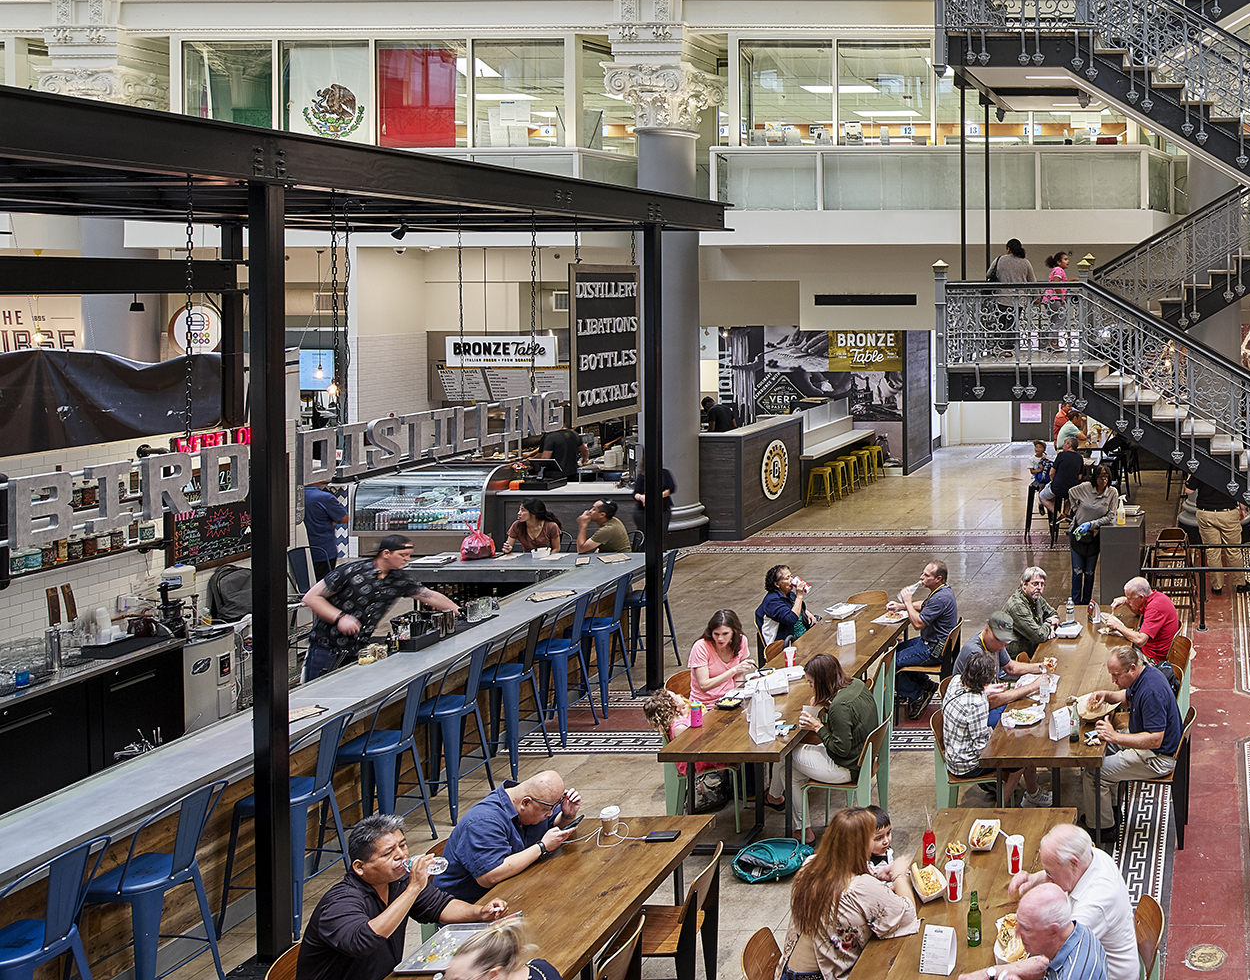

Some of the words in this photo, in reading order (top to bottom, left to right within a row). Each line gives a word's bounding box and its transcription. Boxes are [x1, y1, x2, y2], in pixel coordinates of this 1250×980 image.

[719, 127, 725, 136] 9
[903, 127, 912, 135] 12
[575, 281, 638, 299] DISTILLERY
[2, 310, 24, 326] HE
[577, 316, 638, 336] LIBATIONS
[453, 341, 511, 356] BRONZE
[510, 341, 546, 356] Table
[837, 333, 895, 347] BRONZE
[579, 349, 638, 372] BOTTLES
[849, 348, 885, 363] Table
[577, 381, 639, 408] COCKTAILS
[297, 391, 564, 486] DISTILLING
[8, 443, 250, 550] BIRD
